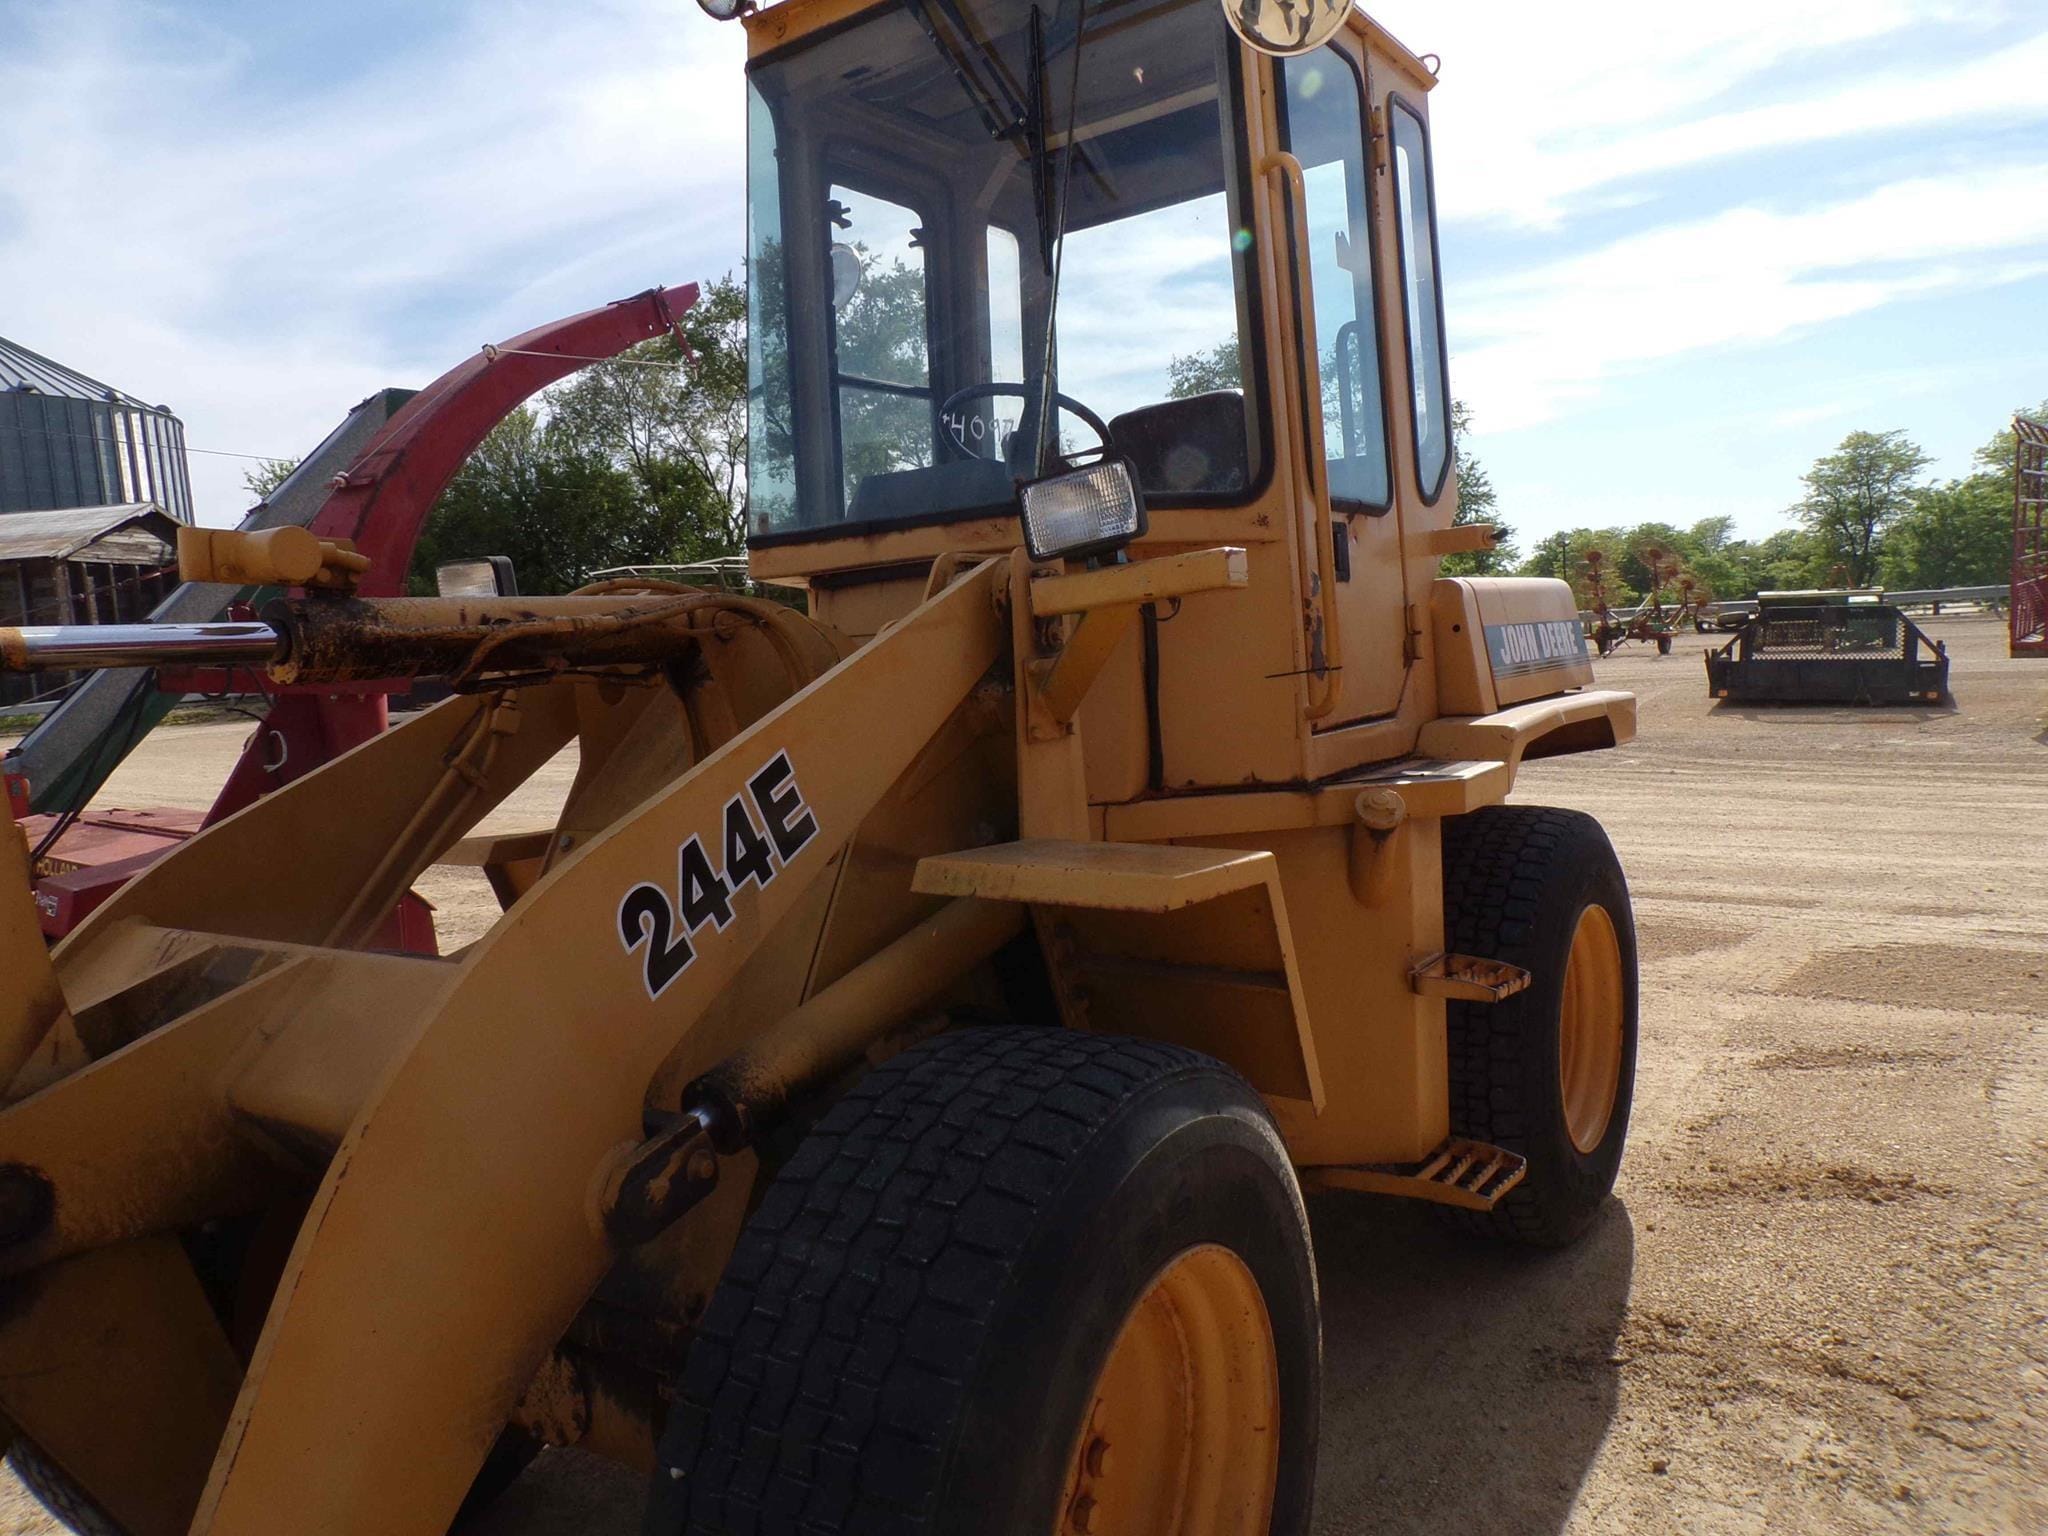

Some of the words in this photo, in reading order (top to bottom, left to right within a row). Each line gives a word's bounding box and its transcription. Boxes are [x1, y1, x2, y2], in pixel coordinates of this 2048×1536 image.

[1501, 624, 1540, 664] JOHN
[1538, 621, 1579, 658] DEERE
[617, 748, 820, 1001] 244E
